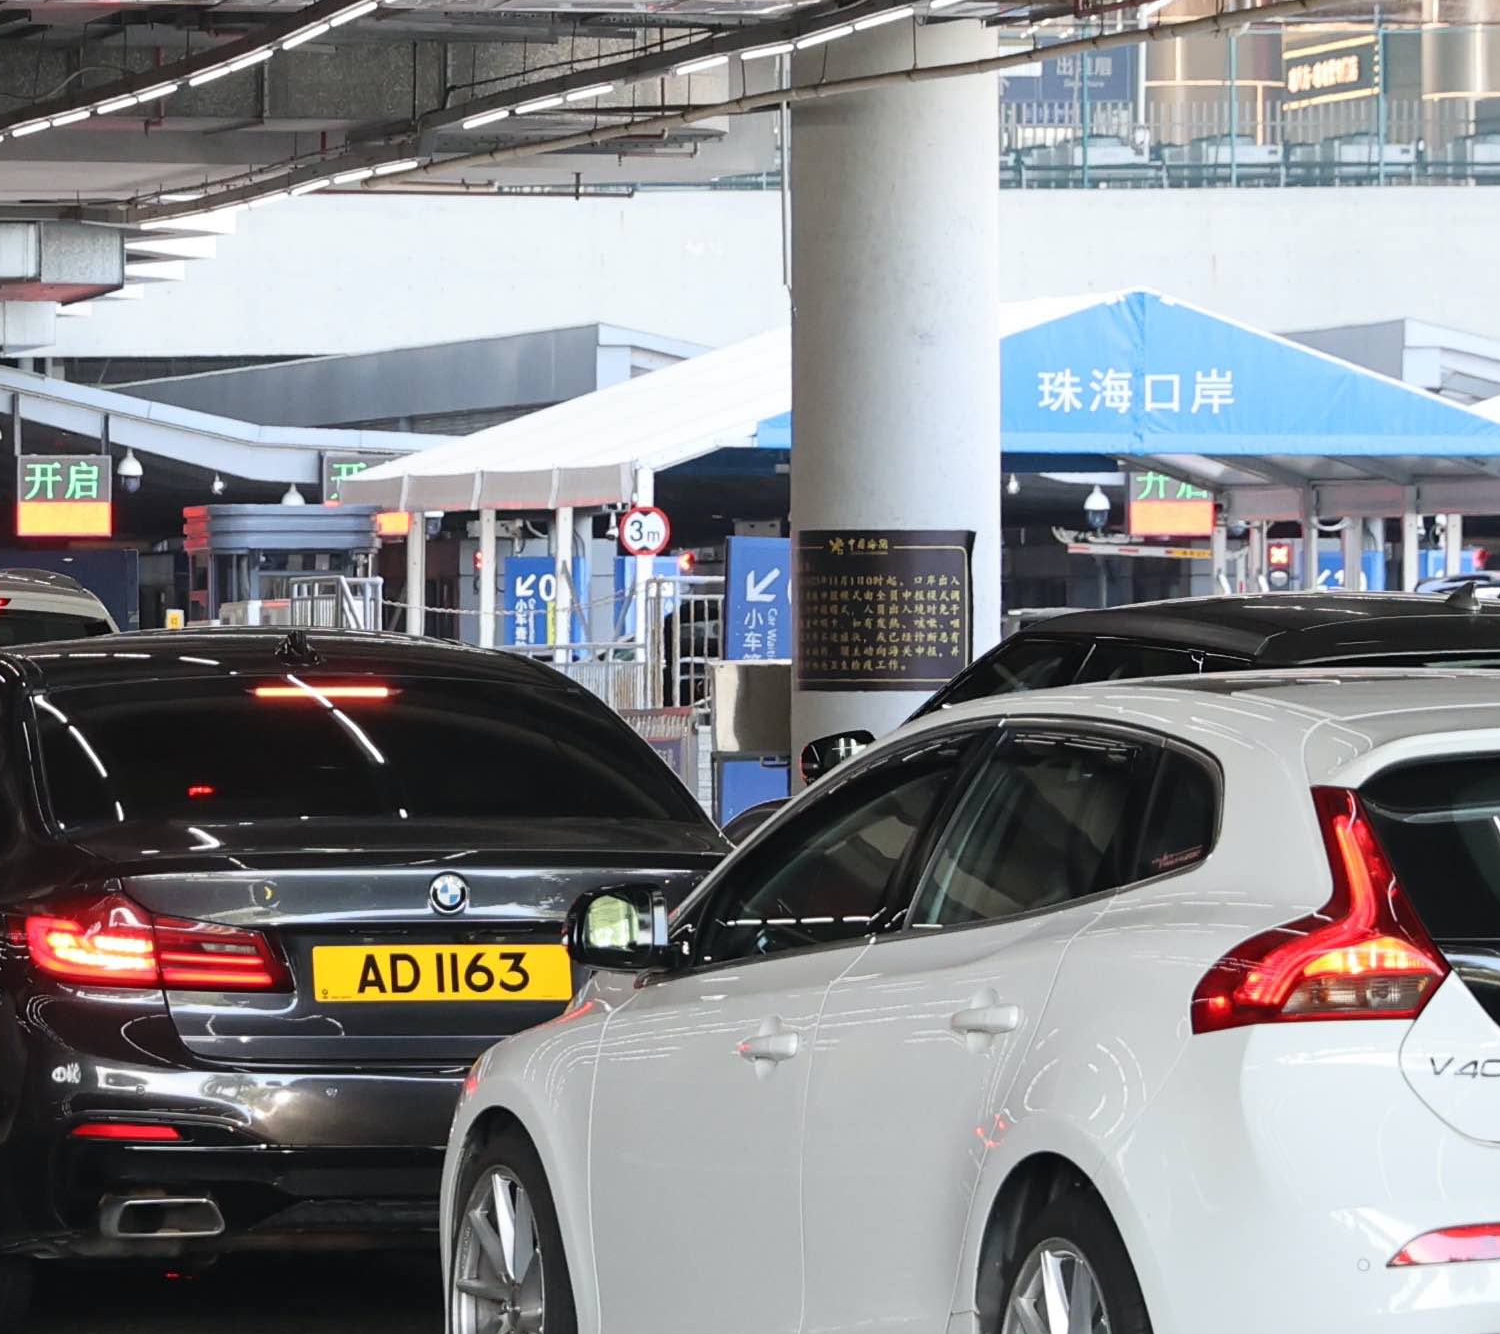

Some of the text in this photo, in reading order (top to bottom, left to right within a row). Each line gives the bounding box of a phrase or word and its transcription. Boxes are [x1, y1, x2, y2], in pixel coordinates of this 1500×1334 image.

[1037, 368, 1235, 414] 珠海口岸
[25, 461, 99, 500] 开启
[357, 952, 530, 994] AD 1163
